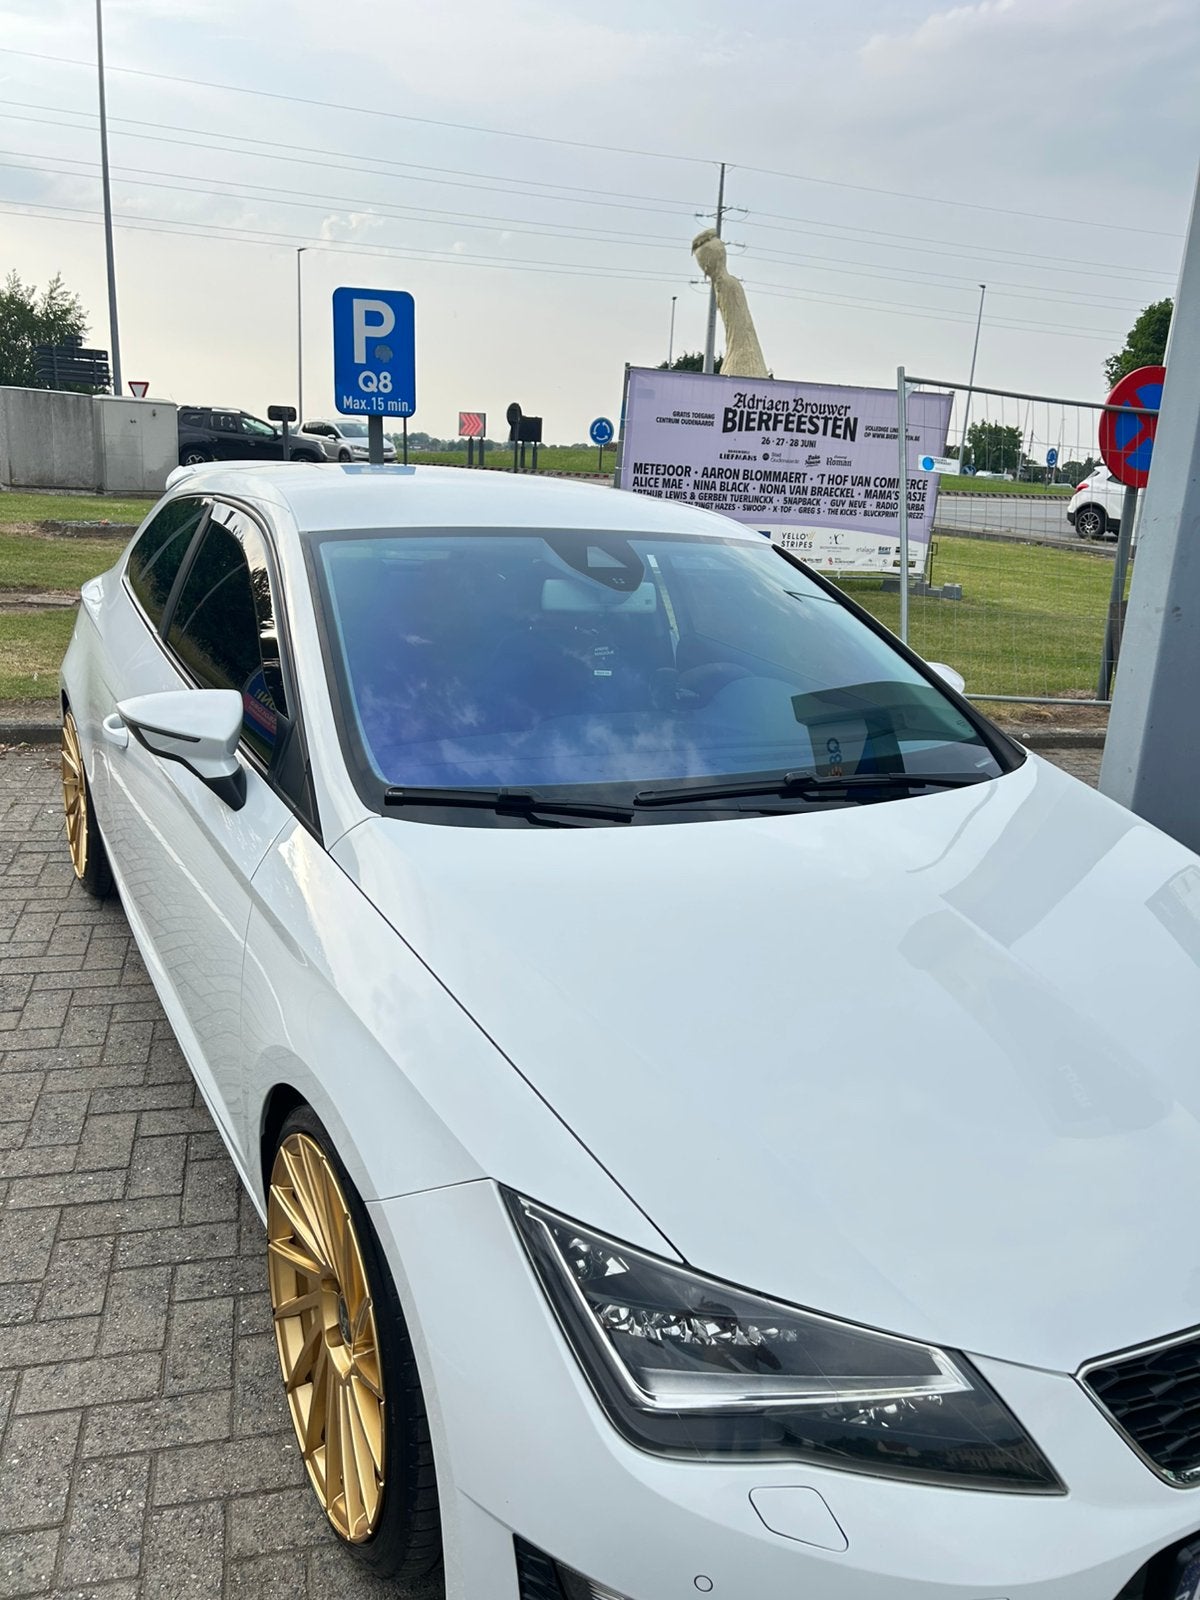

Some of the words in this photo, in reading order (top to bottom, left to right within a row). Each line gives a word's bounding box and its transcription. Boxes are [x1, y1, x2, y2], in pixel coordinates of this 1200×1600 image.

[352, 298, 396, 364] P
[358, 370, 393, 394] Q8
[387, 397, 412, 413] min.
[733, 392, 790, 412] Adriaen
[792, 397, 851, 417] Brouwer
[655, 416, 680, 425] CENTRUM
[681, 418, 715, 427] OUDENAARDE
[672, 410, 691, 418] GRATIS
[692, 411, 715, 420] TOEGANG
[722, 406, 859, 442] BIERFEESTEN
[761, 436, 771, 445] 26
[775, 437, 785, 446] 27
[789, 438, 799, 447] 28
[800, 439, 817, 448] JUNI
[719, 453, 757, 462] LIEFMANS
[826, 456, 852, 467] Roman
[632, 462, 692, 477] METEJOOR
[701, 466, 740, 480] AARON
[742, 470, 808, 484] BLOMMAERT
[827, 474, 849, 487] HOF
[851, 475, 872, 488] VAN
[632, 476, 659, 488] ALICE
[661, 478, 684, 490] MAE
[693, 479, 717, 491] NINA
[719, 481, 750, 493] BLACK
[758, 483, 787, 495] NONA
[789, 485, 808, 496] VAN
[810, 486, 855, 499] BRAECKEL
[864, 489, 900, 501] MAMA'S
[665, 491, 688, 500] LEWIS
[689, 491, 696, 501] &
[698, 492, 728, 502] GERBEN
[730, 493, 774, 505] TUERLINCKX
[783, 496, 822, 506] SNAPBACK
[830, 498, 847, 508] GUY
[848, 499, 867, 509] NEVE
[875, 501, 899, 511] RADIO
[714, 503, 736, 511] HAZES
[742, 503, 767, 512] SWOOP
[798, 506, 816, 514] GREG
[816, 507, 821, 515] S
[827, 507, 838, 516] THE
[839, 508, 858, 517] KICKS
[863, 510, 899, 519] BLVCKPRINT
[781, 540, 813, 549] STRIPES
